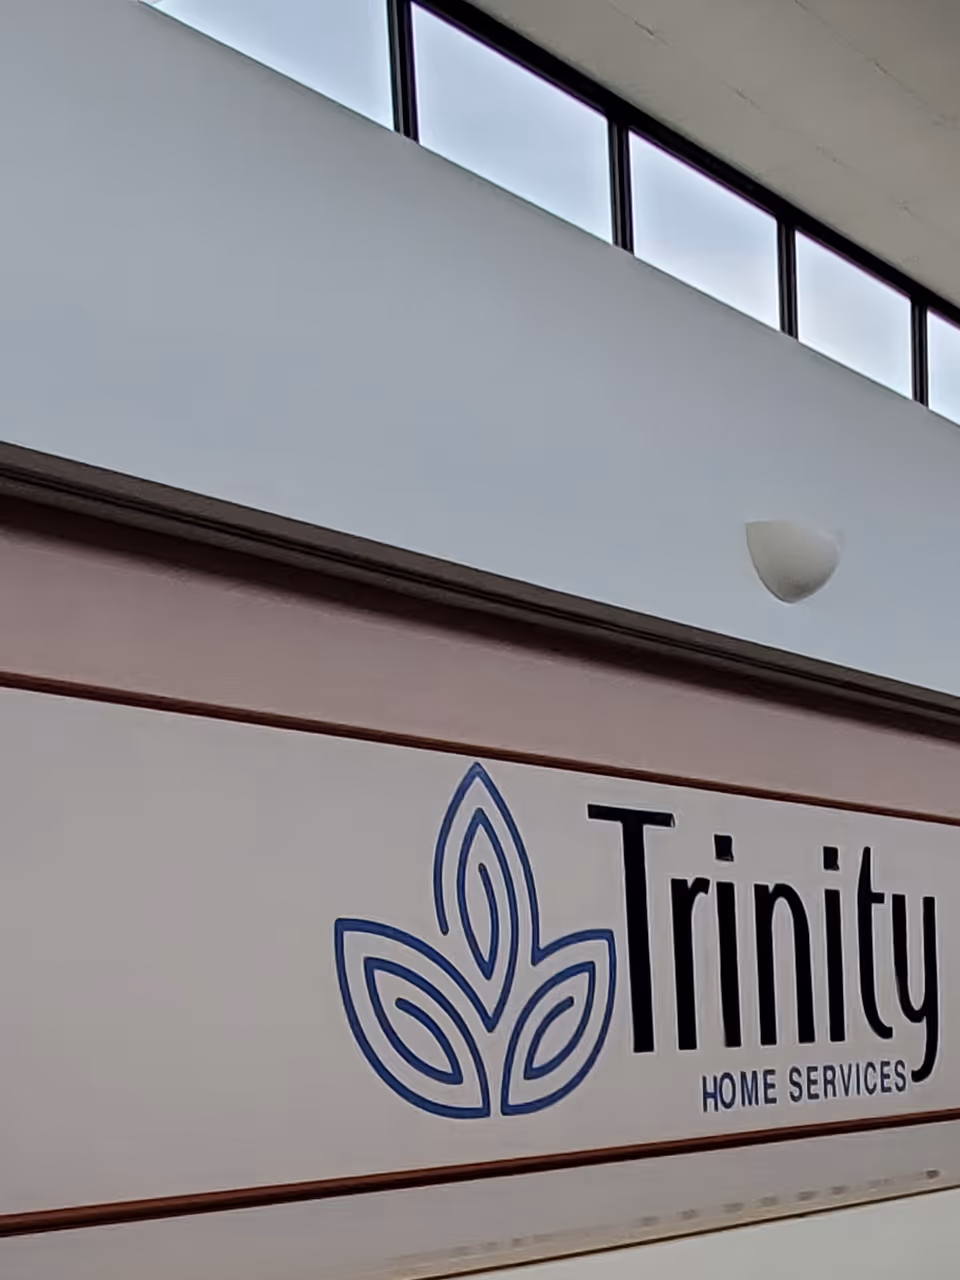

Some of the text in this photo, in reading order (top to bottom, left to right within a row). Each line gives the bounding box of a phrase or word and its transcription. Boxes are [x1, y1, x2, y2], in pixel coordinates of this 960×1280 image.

[587, 803, 939, 1083] Trinity
[701, 1059, 908, 1113] HOME SERVICES
